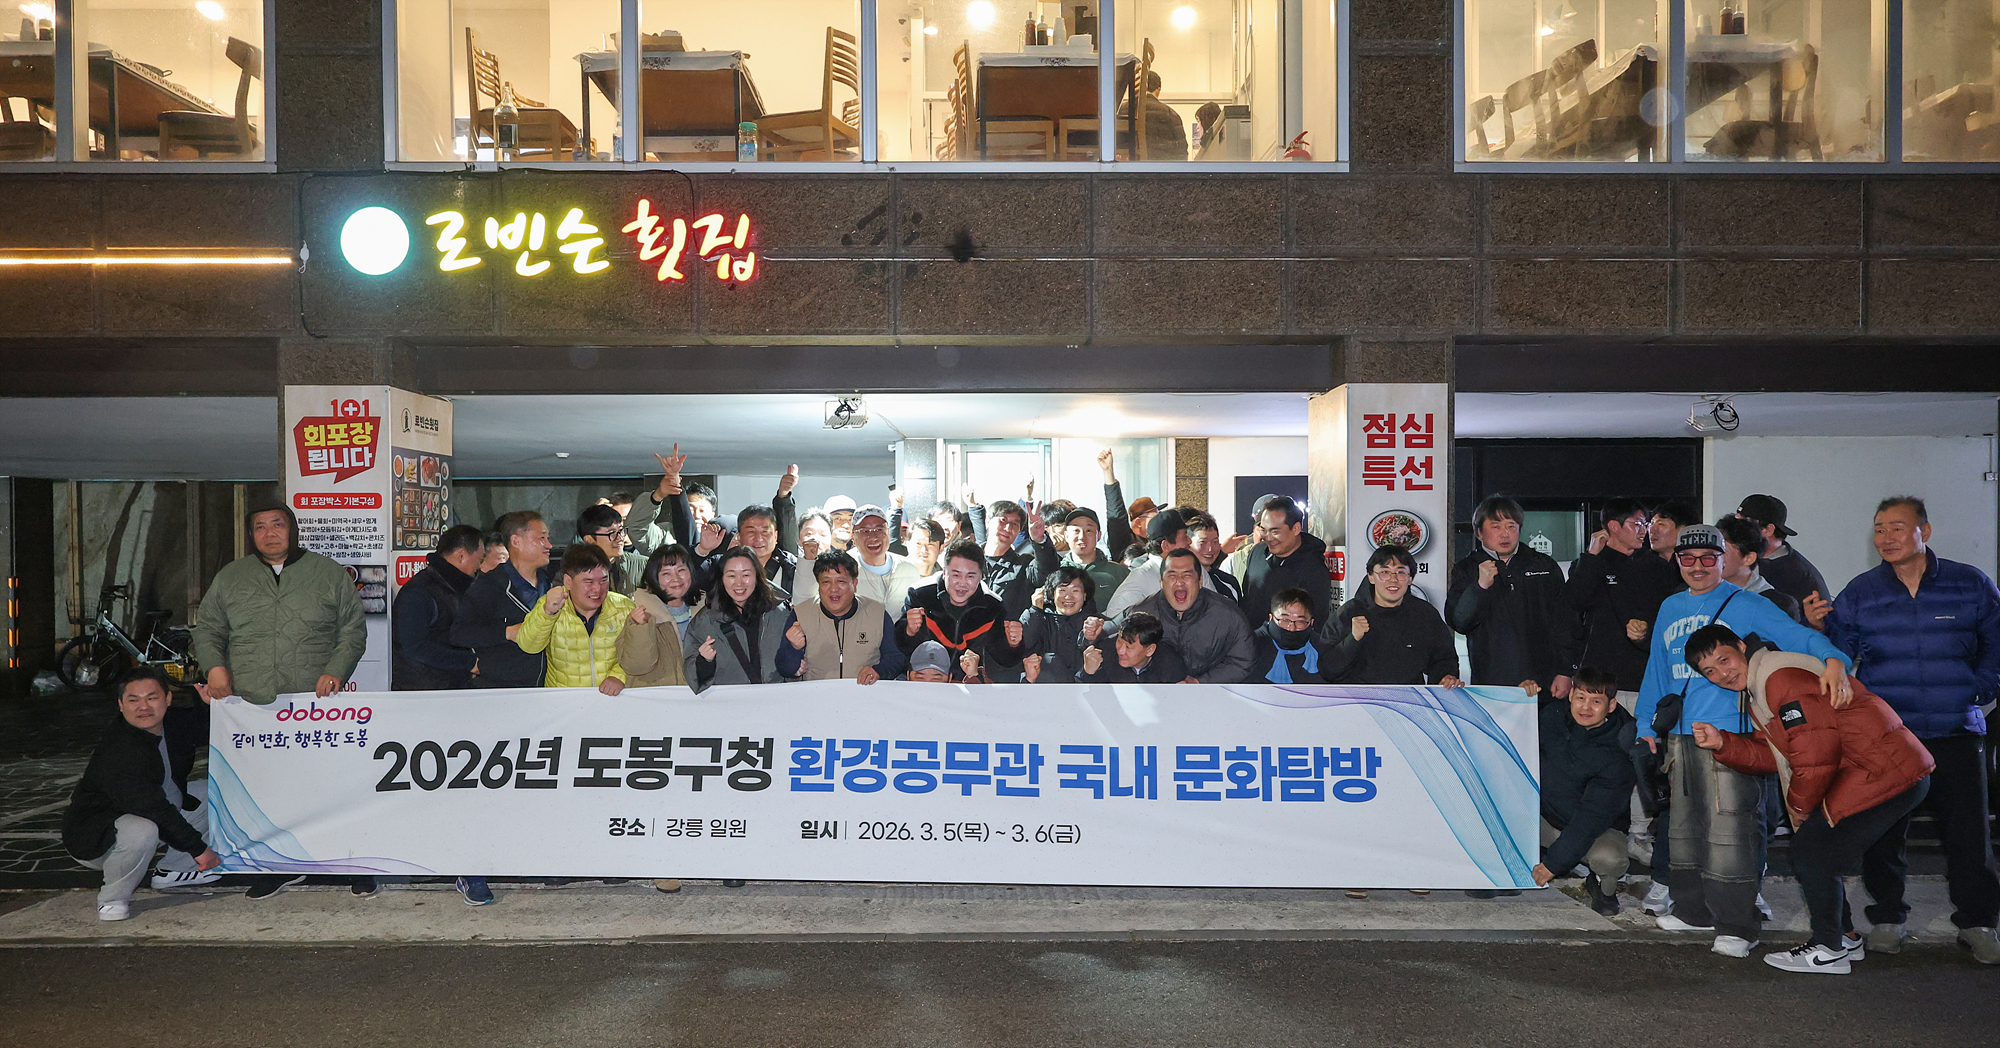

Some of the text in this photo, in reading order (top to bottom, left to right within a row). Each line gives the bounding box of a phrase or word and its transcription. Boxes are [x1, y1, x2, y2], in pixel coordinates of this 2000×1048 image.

[425, 198, 756, 282] 로빈손 횟집
[303, 421, 374, 447] 회포장
[415, 415, 439, 432] 로빈손횟집
[1362, 413, 1434, 449] 점심
[307, 446, 373, 471] 됩니다
[1362, 455, 1434, 491] 특선
[300, 496, 375, 506] 회 포장박스 기본구성
[276, 702, 372, 724] dobong
[231, 729, 369, 749] 같이 변화, 행복한 도봉
[373, 736, 1382, 804] 2026년 도봉구청 환경공무관 국내 문화탐방
[609, 817, 747, 838] 장소 강릉 일원
[801, 820, 838, 840] 일시
[859, 821, 914, 841] 2026.
[921, 822, 937, 842] 3.
[944, 822, 989, 844] 5(목)
[1012, 824, 1029, 843] 3.
[1035, 824, 1081, 845] 6(금)
